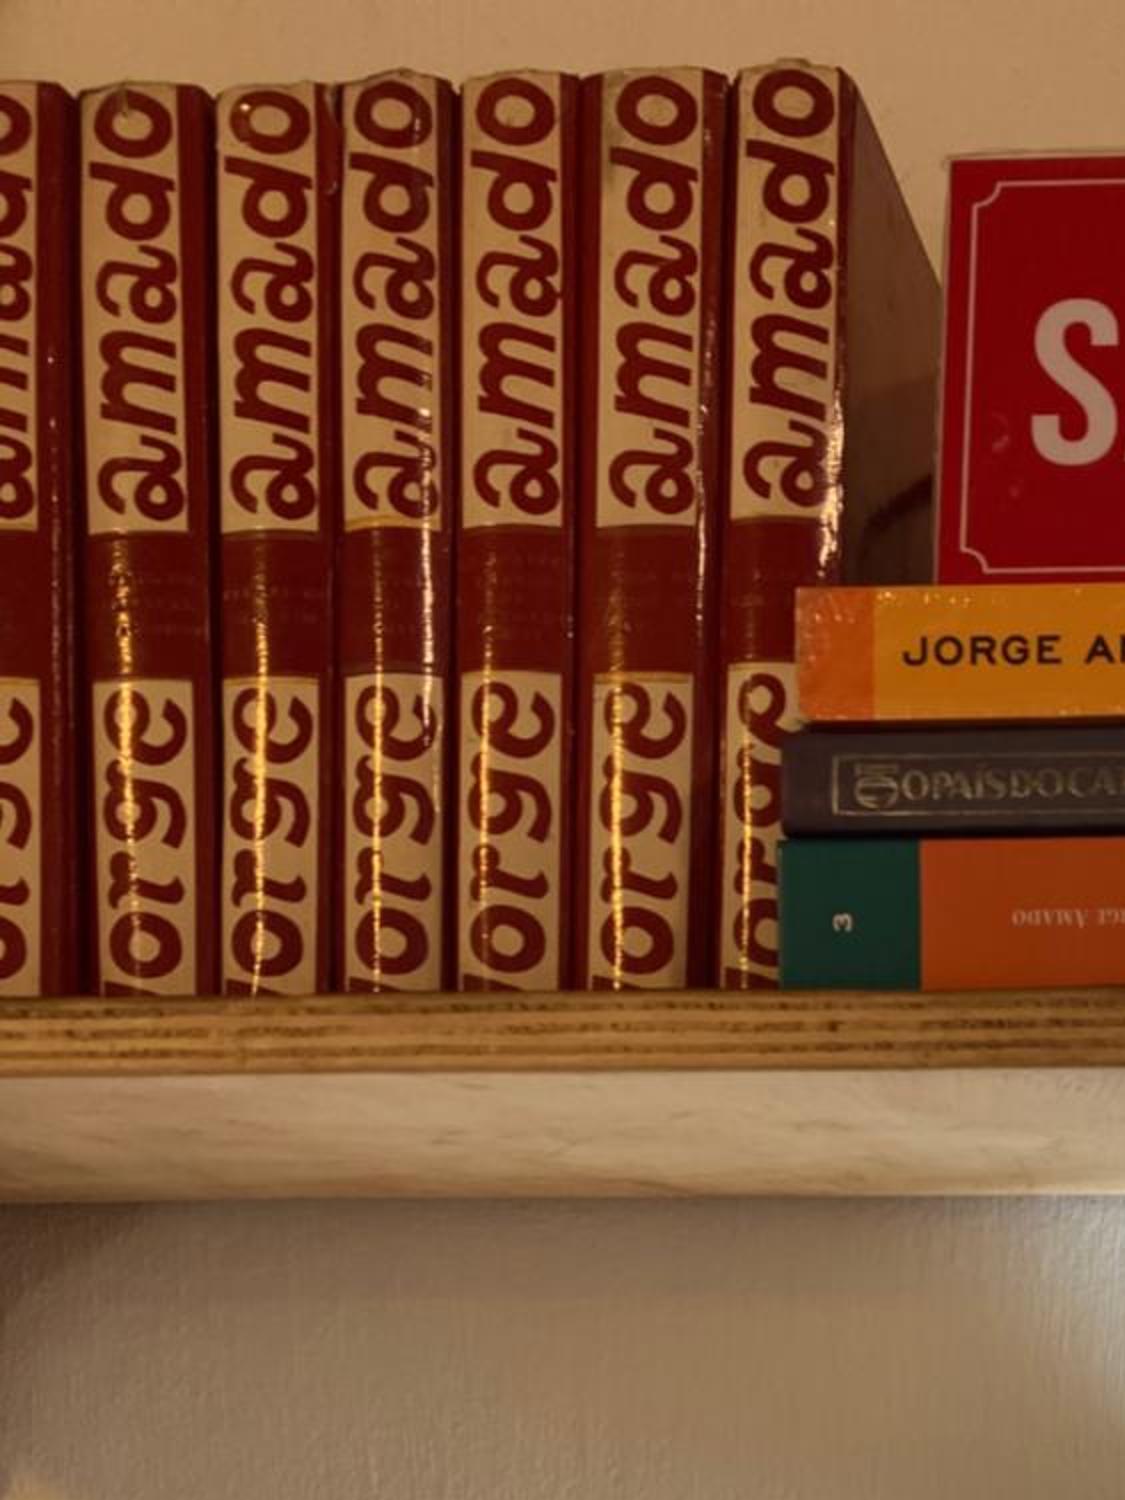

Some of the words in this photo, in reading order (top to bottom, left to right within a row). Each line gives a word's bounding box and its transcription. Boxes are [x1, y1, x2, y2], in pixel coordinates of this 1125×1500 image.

[89, 88, 185, 521] amado
[225, 88, 318, 521] amado
[349, 79, 438, 518] amado
[471, 77, 564, 518] amado
[609, 75, 699, 516] amado
[743, 74, 838, 509] amado
[903, 634, 1062, 666] JORGE
[103, 689, 188, 996] orge
[231, 683, 314, 995] orge
[353, 684, 437, 991] orge
[467, 680, 557, 990] orge
[600, 682, 688, 988] orge
[724, 672, 787, 989] orge
[832, 912, 853, 933] 3
[1010, 908, 1089, 928] AMADO
